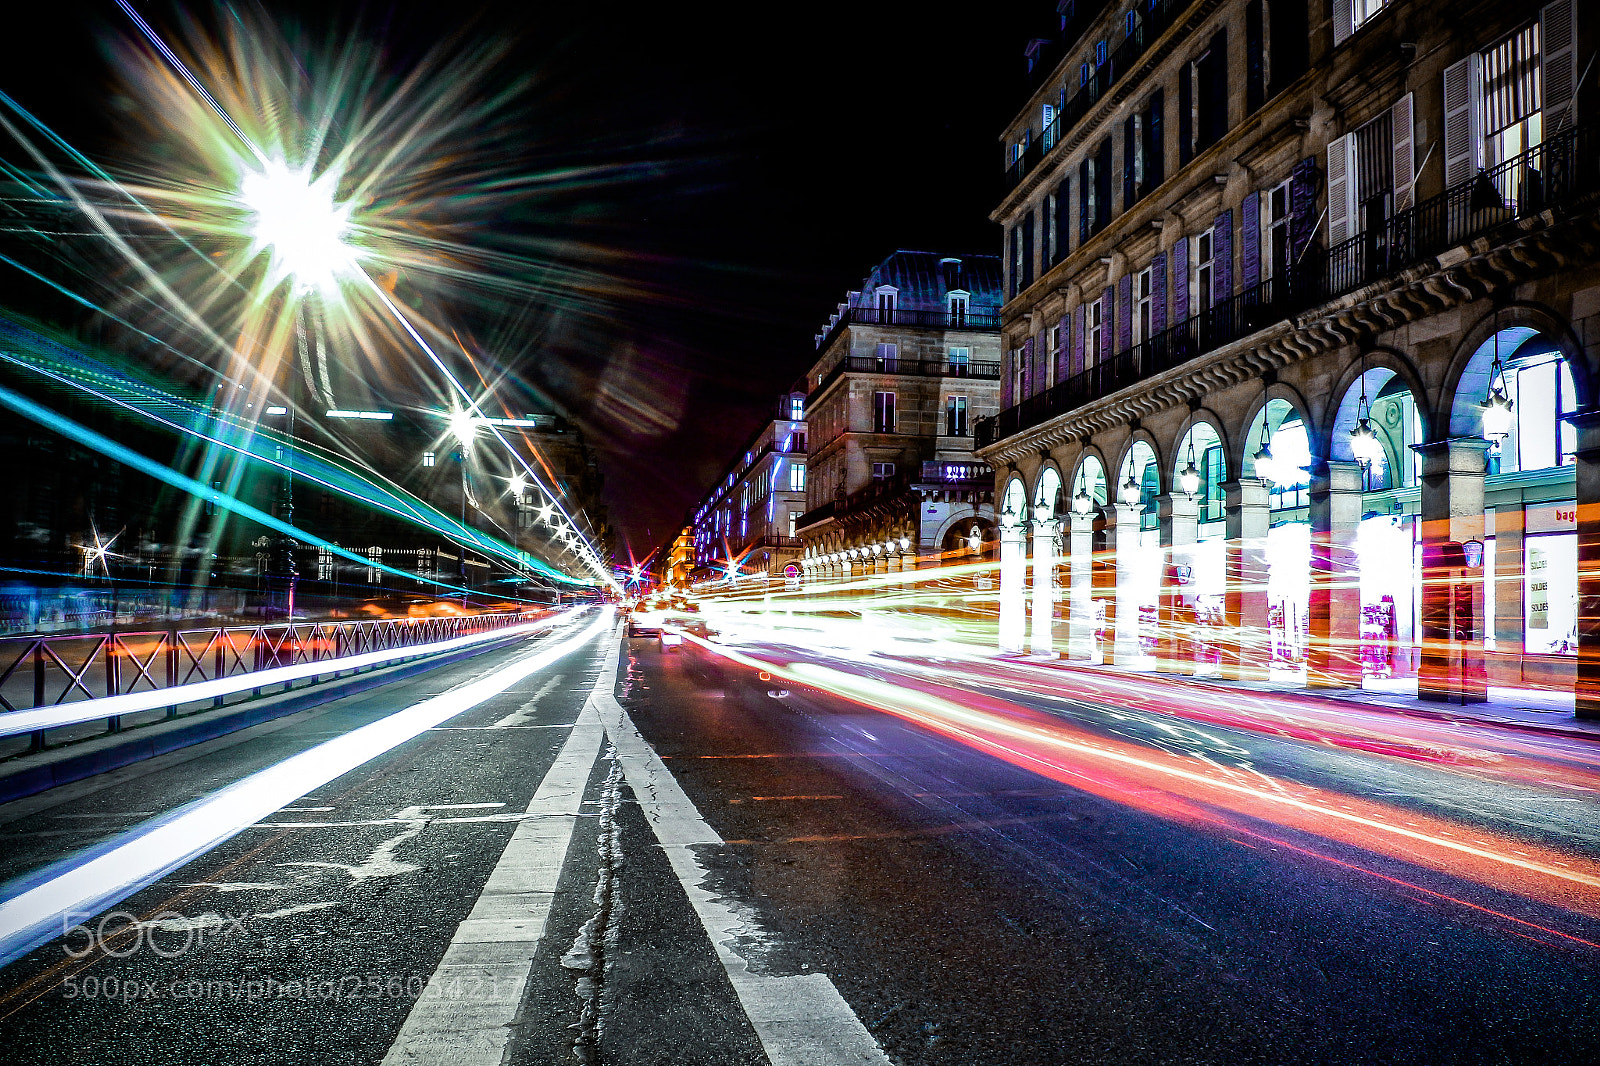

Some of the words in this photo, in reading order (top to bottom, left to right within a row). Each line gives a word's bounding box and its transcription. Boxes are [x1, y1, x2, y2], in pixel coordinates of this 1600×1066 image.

[1556, 509, 1577, 522] bag
[1530, 582, 1548, 592] SOLDES
[1531, 603, 1549, 612] SOLDES
